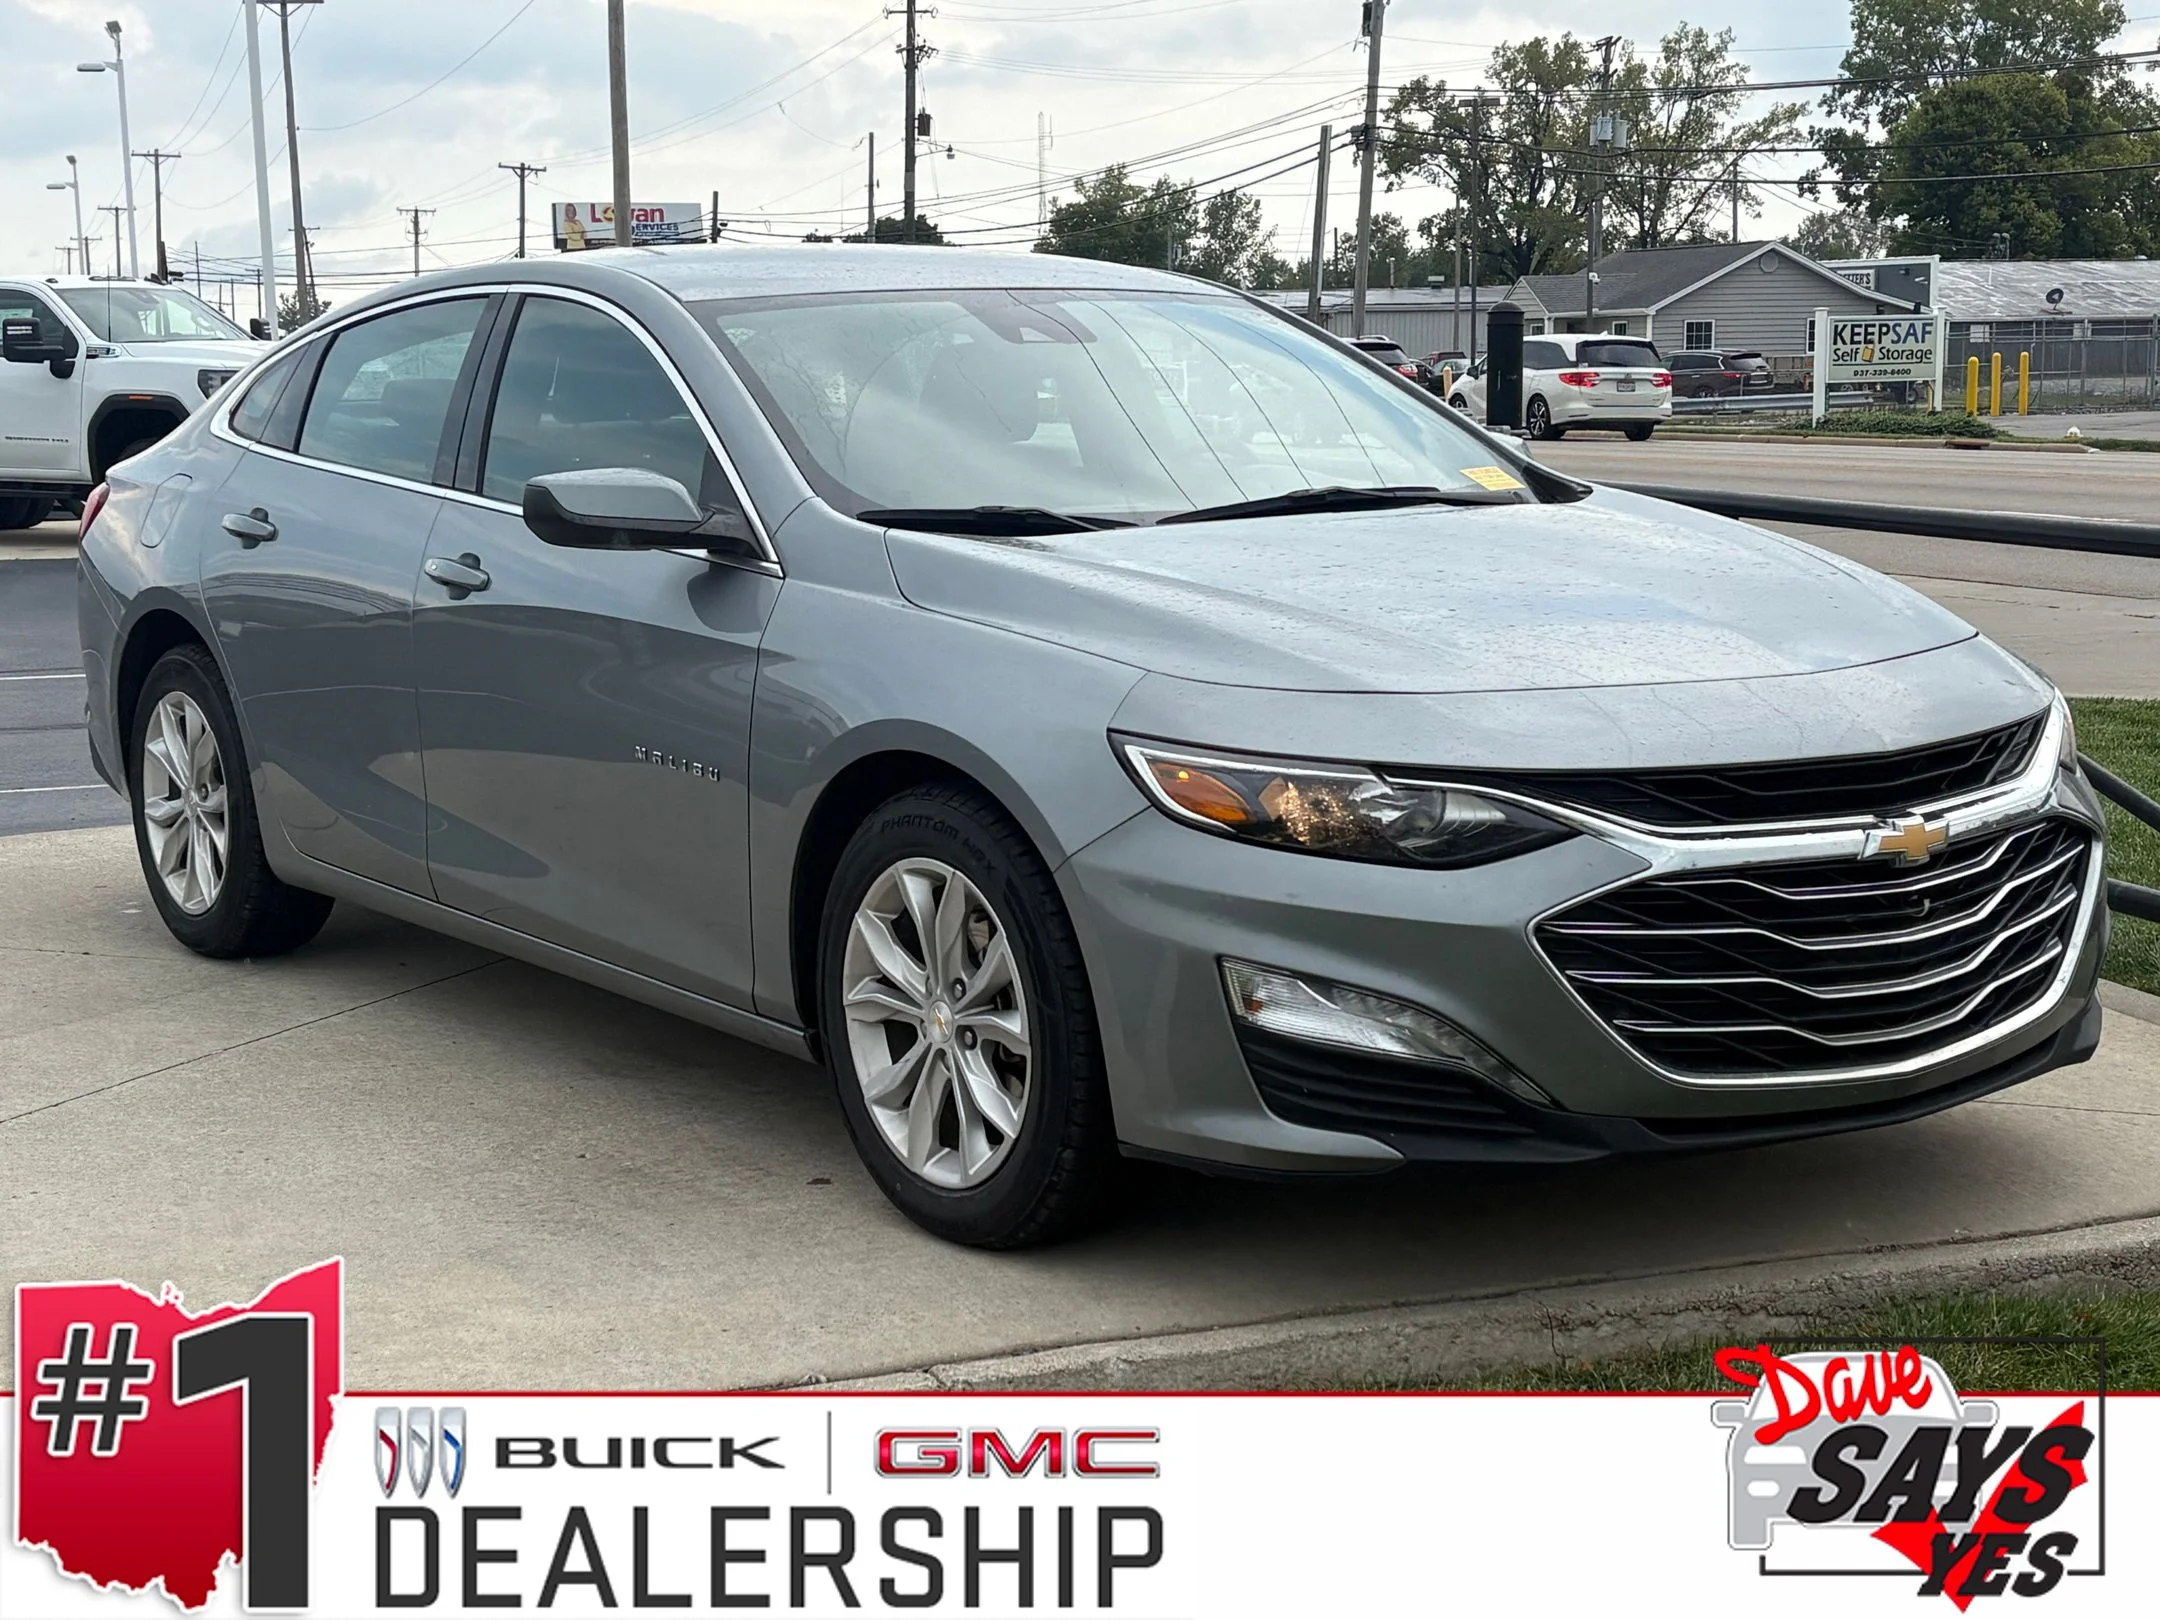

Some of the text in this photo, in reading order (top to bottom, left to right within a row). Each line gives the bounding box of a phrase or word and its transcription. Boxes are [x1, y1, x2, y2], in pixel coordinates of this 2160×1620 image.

[590, 203, 665, 223] Loan
[1833, 322, 1934, 345] KEEPSAF
[1832, 346, 1933, 364] Self Storage
[634, 745, 720, 782] MALIBU
[880, 814, 961, 841] PHANTOM
